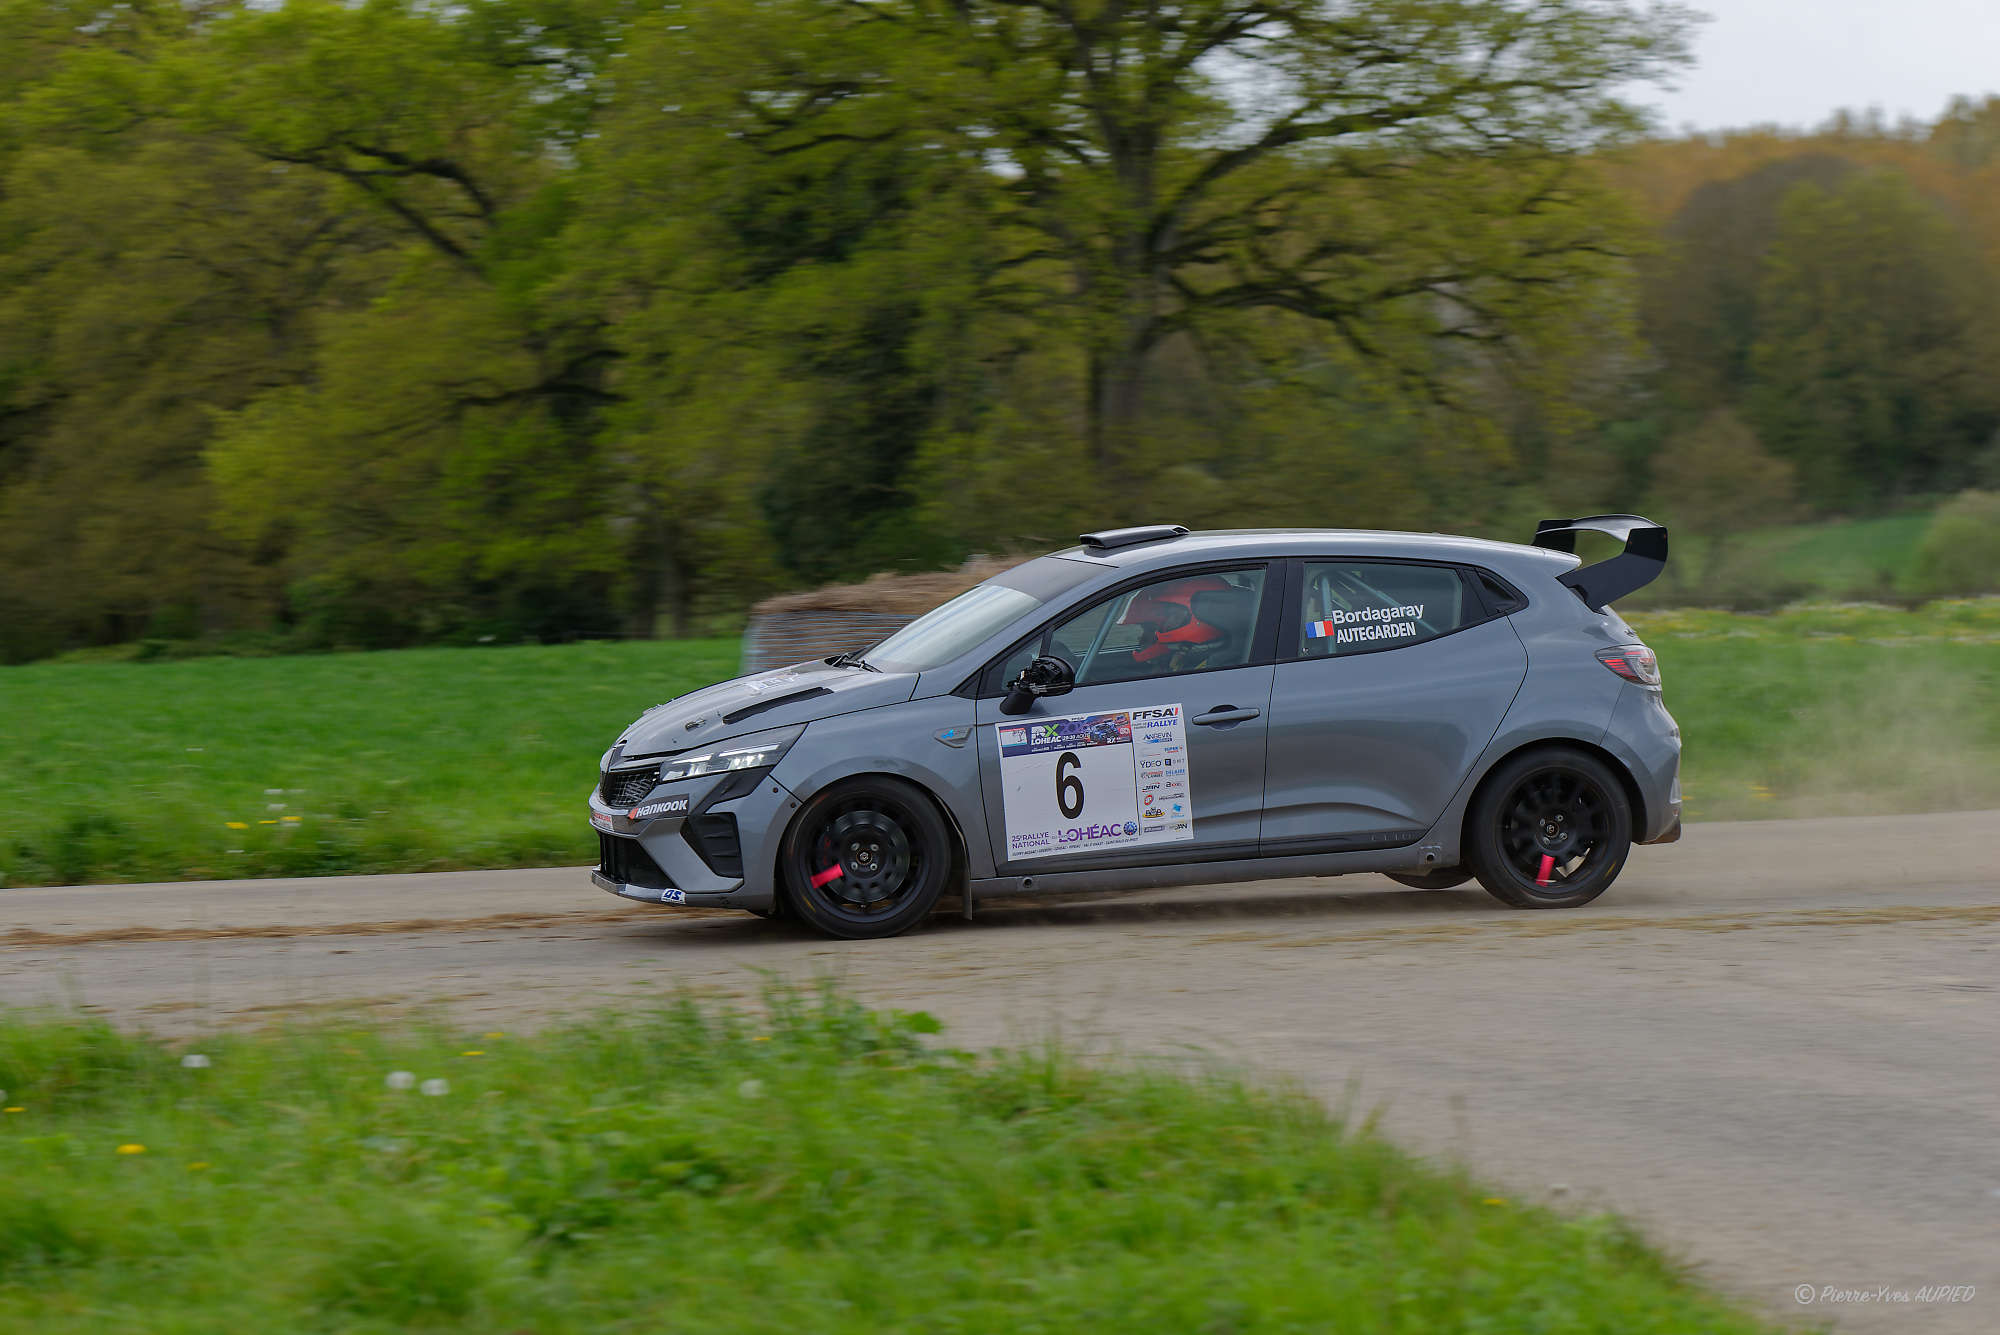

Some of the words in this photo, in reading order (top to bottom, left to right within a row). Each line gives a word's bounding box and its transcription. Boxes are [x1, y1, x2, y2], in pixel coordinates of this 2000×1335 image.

[1332, 604, 1424, 624] Bordagaray
[1337, 621, 1416, 643] AUTEGARDEN
[1133, 708, 1174, 720] FFSA
[1147, 719, 1178, 728] RALLYE
[1056, 751, 1084, 819] 6
[1023, 831, 1050, 840] RALLYE
[1058, 823, 1121, 843] LOHÉAC
[1012, 839, 1051, 849] NATIONAL
